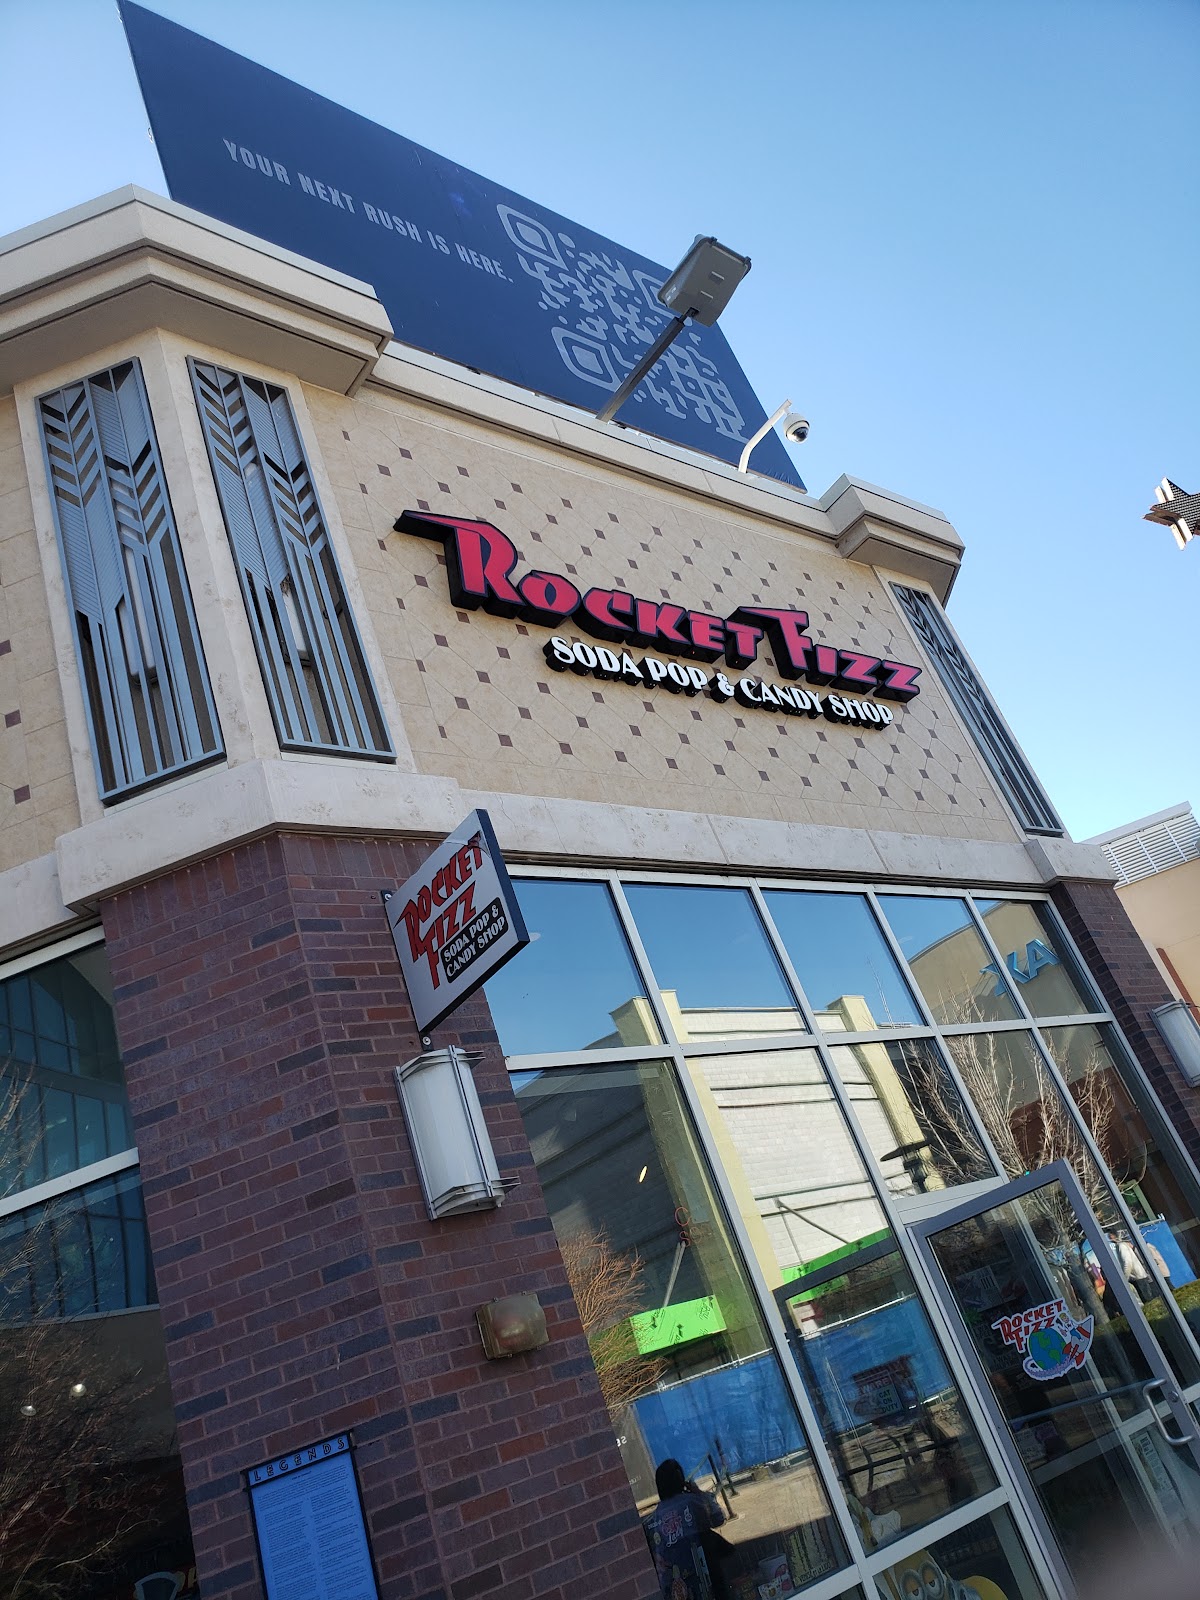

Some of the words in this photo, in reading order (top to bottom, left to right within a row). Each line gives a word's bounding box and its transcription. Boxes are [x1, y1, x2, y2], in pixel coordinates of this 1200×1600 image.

[222, 138, 291, 185] YOUR
[297, 172, 355, 214] NEXT
[362, 201, 423, 243] RUSH
[427, 230, 451, 255] IS
[455, 243, 514, 283] HERE.
[399, 509, 764, 660] ROCKET
[734, 606, 922, 698] FIZZ
[549, 635, 644, 679] SODA
[645, 657, 709, 691] POP
[716, 673, 735, 697] &
[739, 677, 824, 714] CANDY
[828, 694, 894, 725] SHOP
[393, 830, 484, 963] ROCKET
[418, 881, 477, 990] FIZZ
[444, 933, 470, 962] SODA
[469, 912, 490, 939] POP
[491, 904, 499, 918] &
[446, 942, 477, 977] CANDY
[477, 916, 505, 948] SHOP
[992, 1299, 1064, 1343] ROCKET
[1011, 1316, 1057, 1351] FIZZ
[878, 1389, 892, 1398] CAT
[881, 1402, 899, 1412] DUTY
[253, 1437, 345, 1481] LEGENDS
